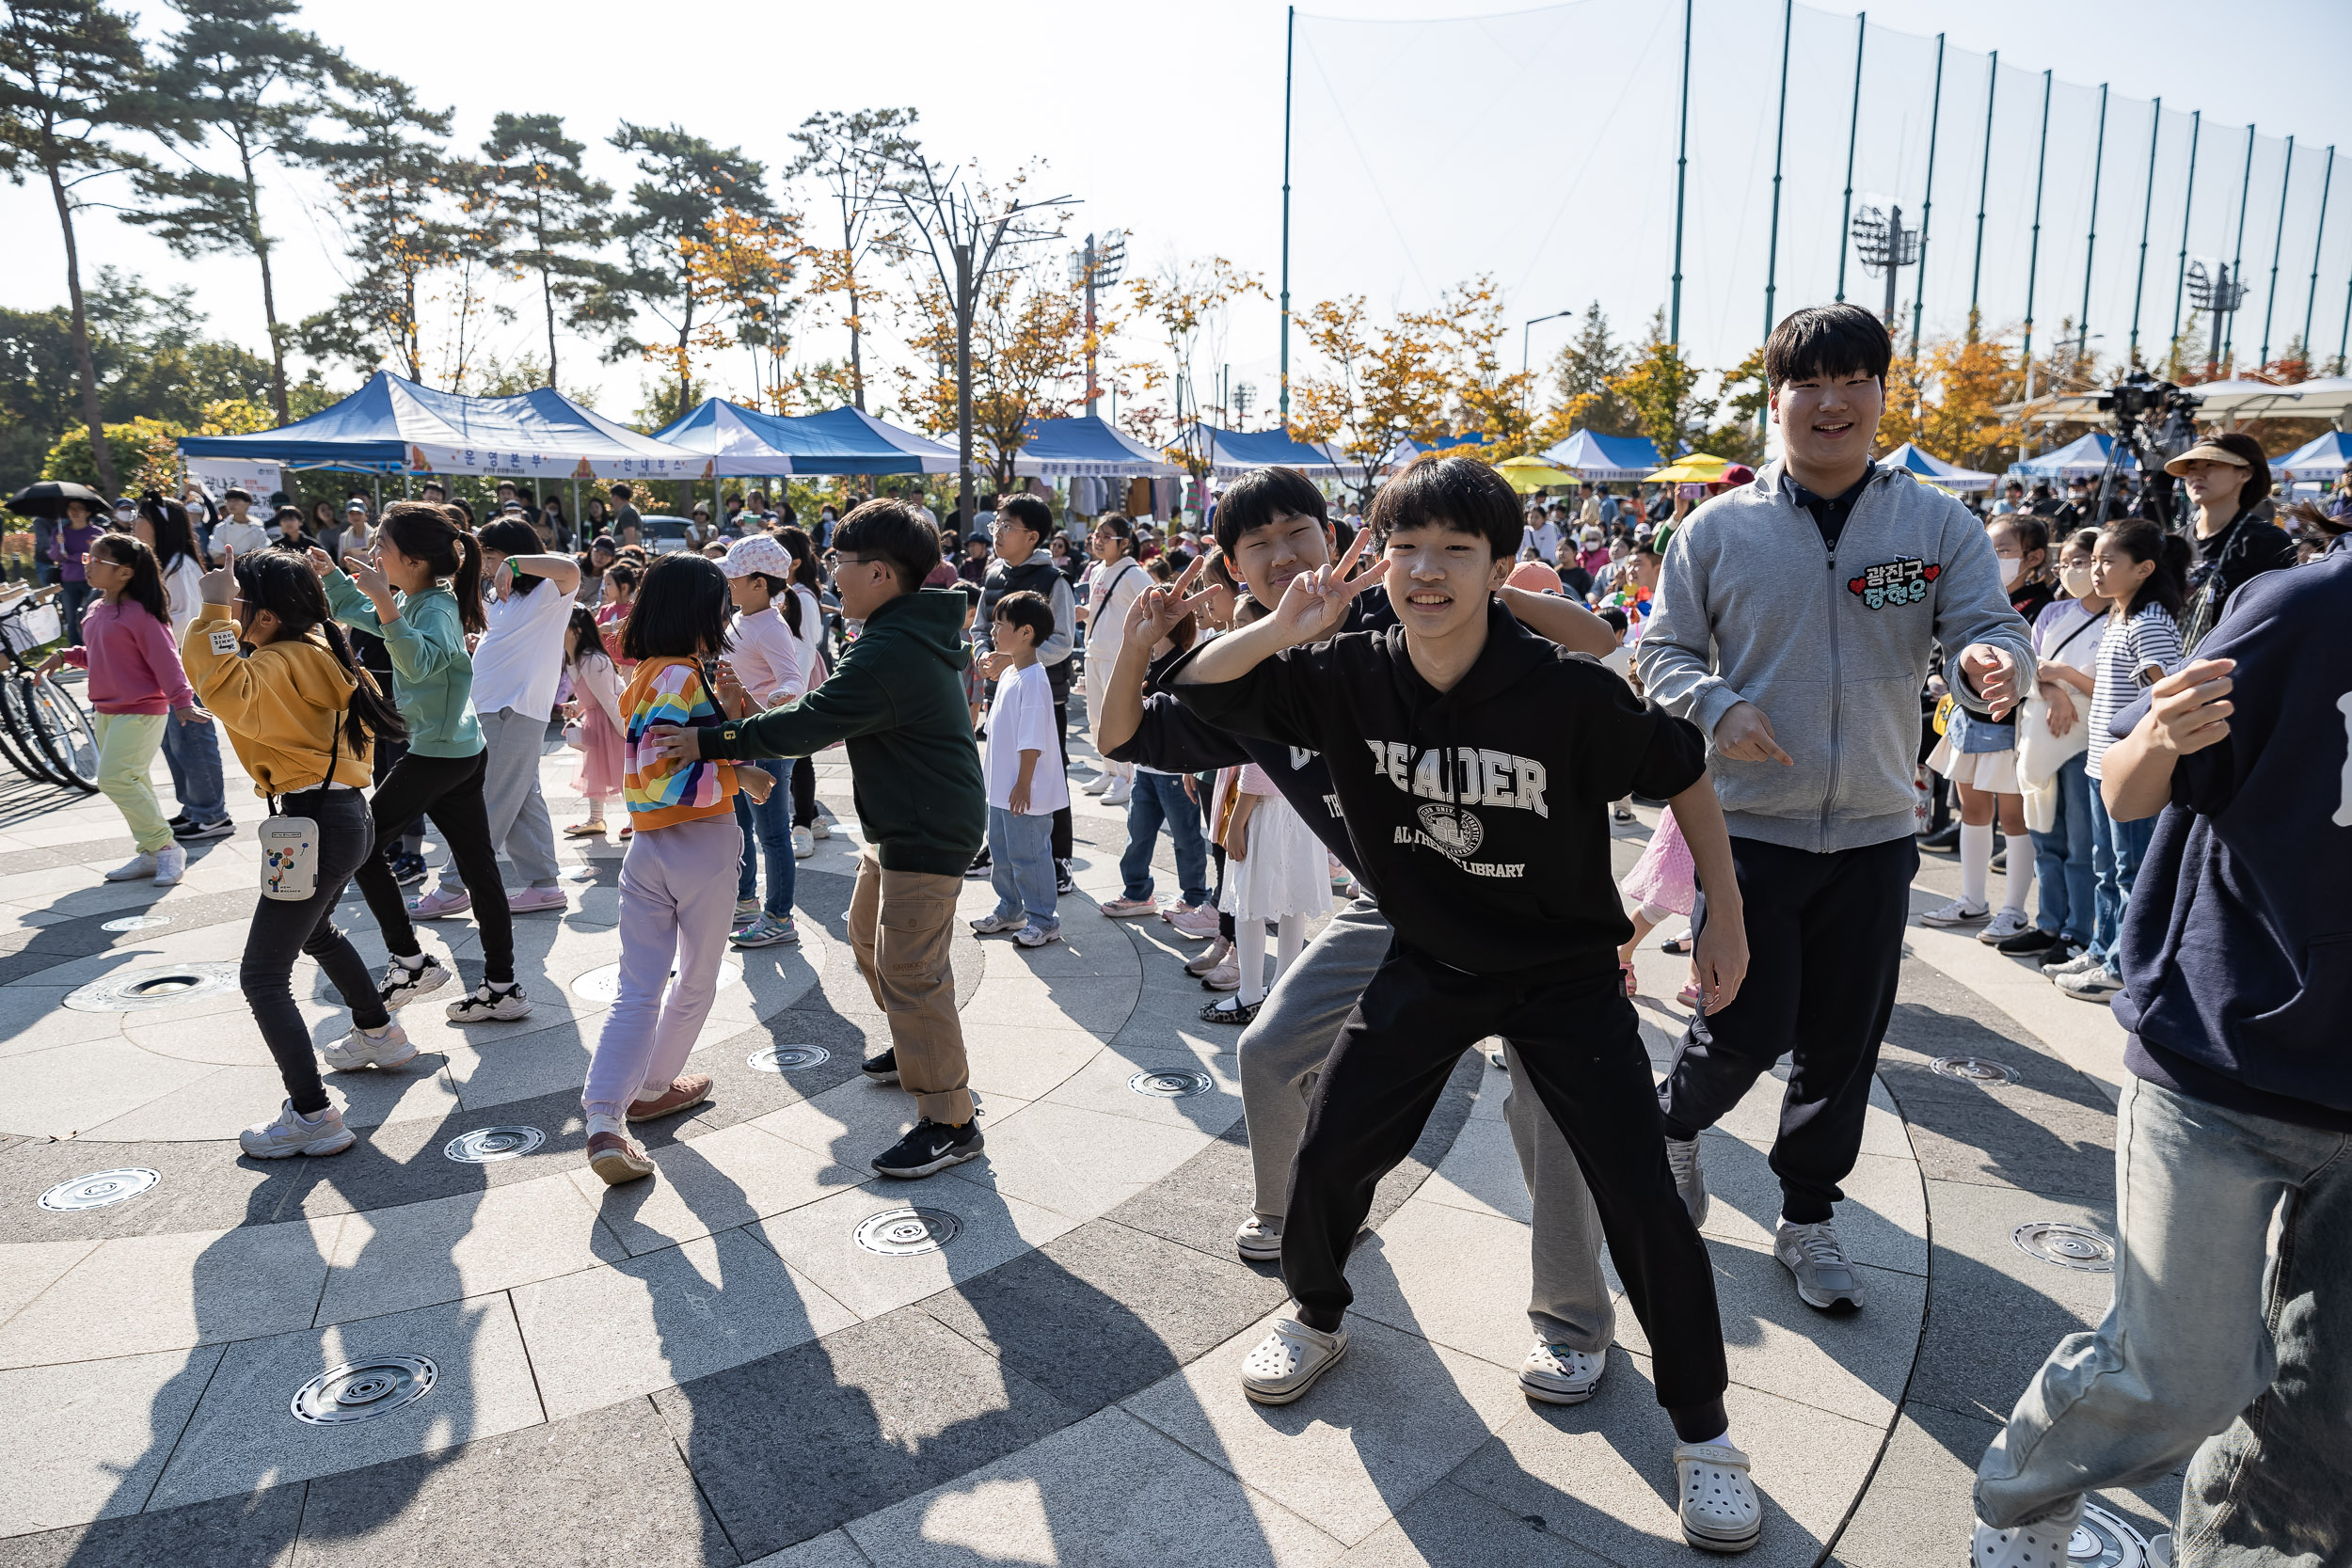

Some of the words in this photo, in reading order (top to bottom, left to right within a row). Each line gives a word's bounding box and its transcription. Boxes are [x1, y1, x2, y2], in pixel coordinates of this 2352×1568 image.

[465, 450, 542, 468] 운영본부
[623, 458, 681, 471] 안내부스
[1867, 561, 1923, 587] 광진구
[1462, 813, 1480, 842] UTHENTIC
[1462, 860, 1526, 878] LIBRARY
